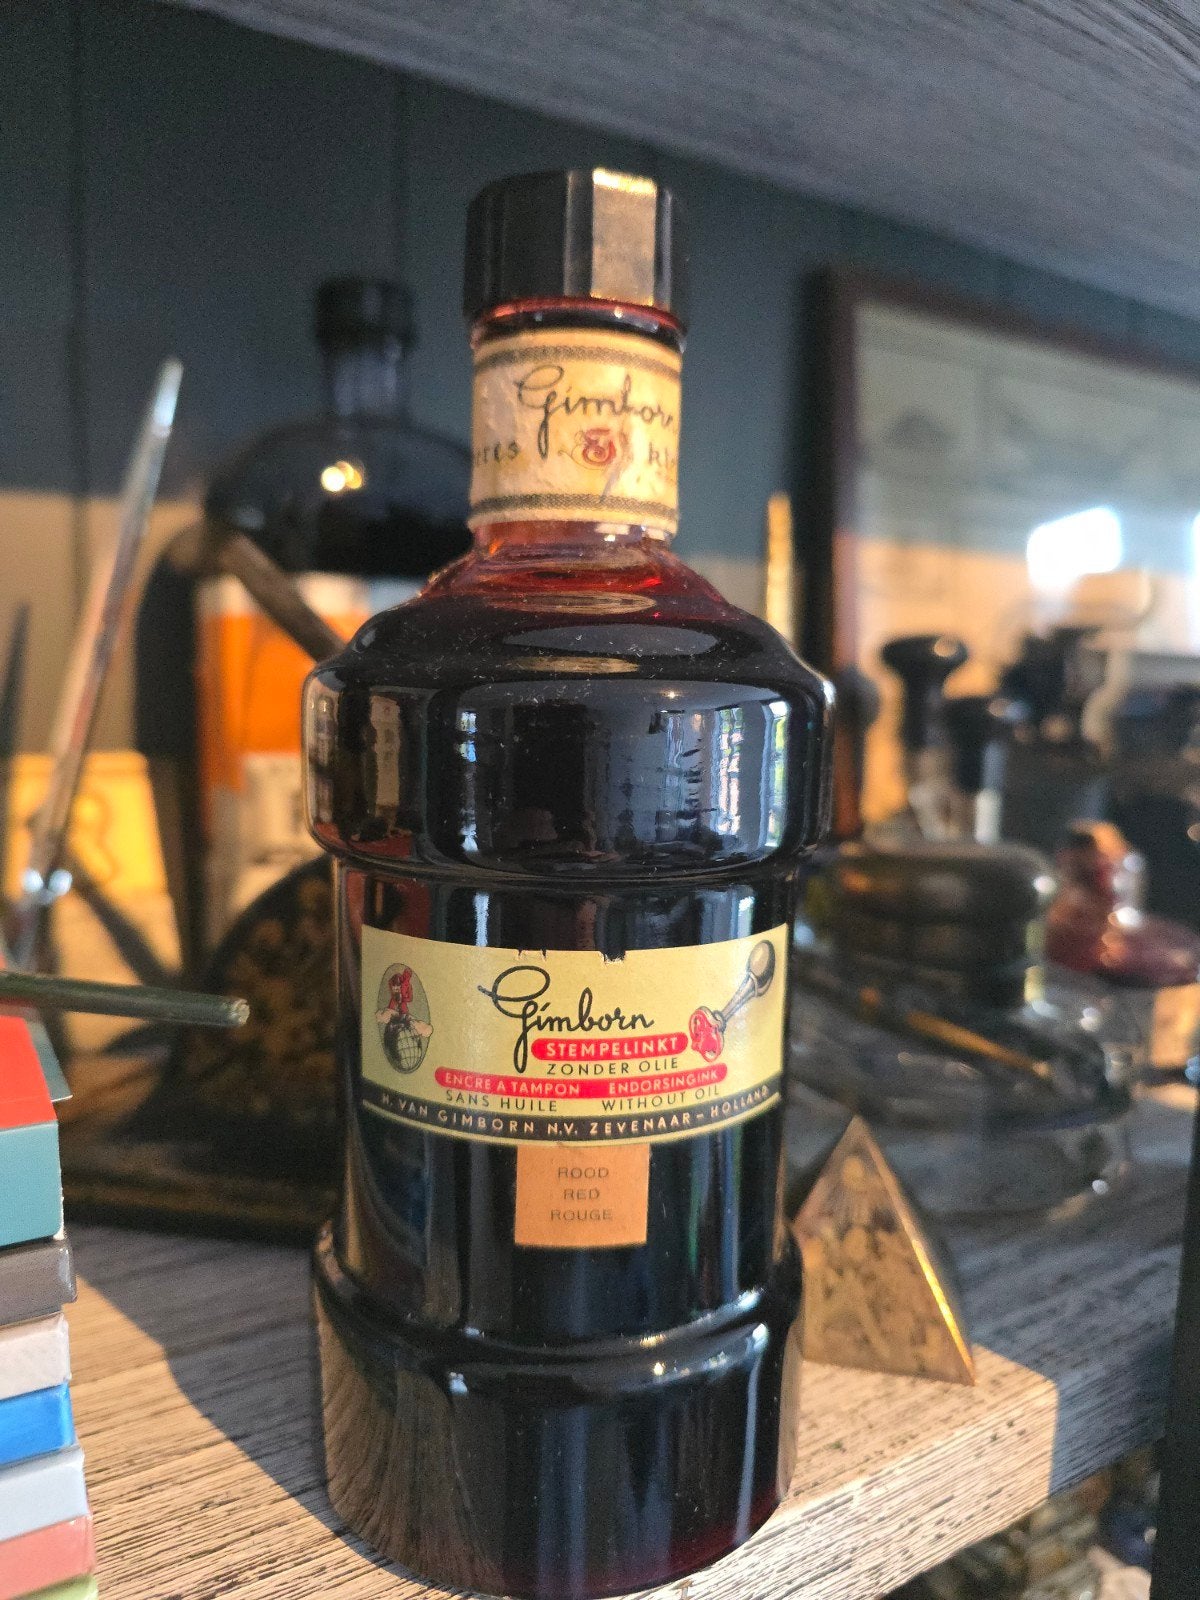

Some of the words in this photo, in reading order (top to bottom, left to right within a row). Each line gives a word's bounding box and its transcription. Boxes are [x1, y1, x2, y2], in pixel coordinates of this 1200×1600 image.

[476, 965, 656, 1074] Gimborn
[546, 1036, 679, 1058] STEMPELINKT
[546, 1062, 630, 1076] ZONDER
[638, 1057, 679, 1073] OLIE
[444, 1072, 492, 1090] ENCRE
[496, 1081, 507, 1092] A
[511, 1081, 580, 1096] TAMPON
[608, 1068, 719, 1095] ENDORSINGINK
[445, 1089, 490, 1107] SANS
[500, 1097, 558, 1113] HUILE
[601, 1092, 685, 1112] WITHOUT
[694, 1084, 720, 1101] OIL
[400, 1101, 429, 1118] VAN
[437, 1109, 535, 1134] GIMBORN
[547, 1121, 578, 1136] N.V.
[589, 1112, 690, 1136] ZEVENAAR
[710, 1084, 770, 1118] HOLLAND
[557, 1166, 610, 1179] ROOD
[563, 1188, 601, 1200] RED
[550, 1208, 614, 1221] ROUGE
